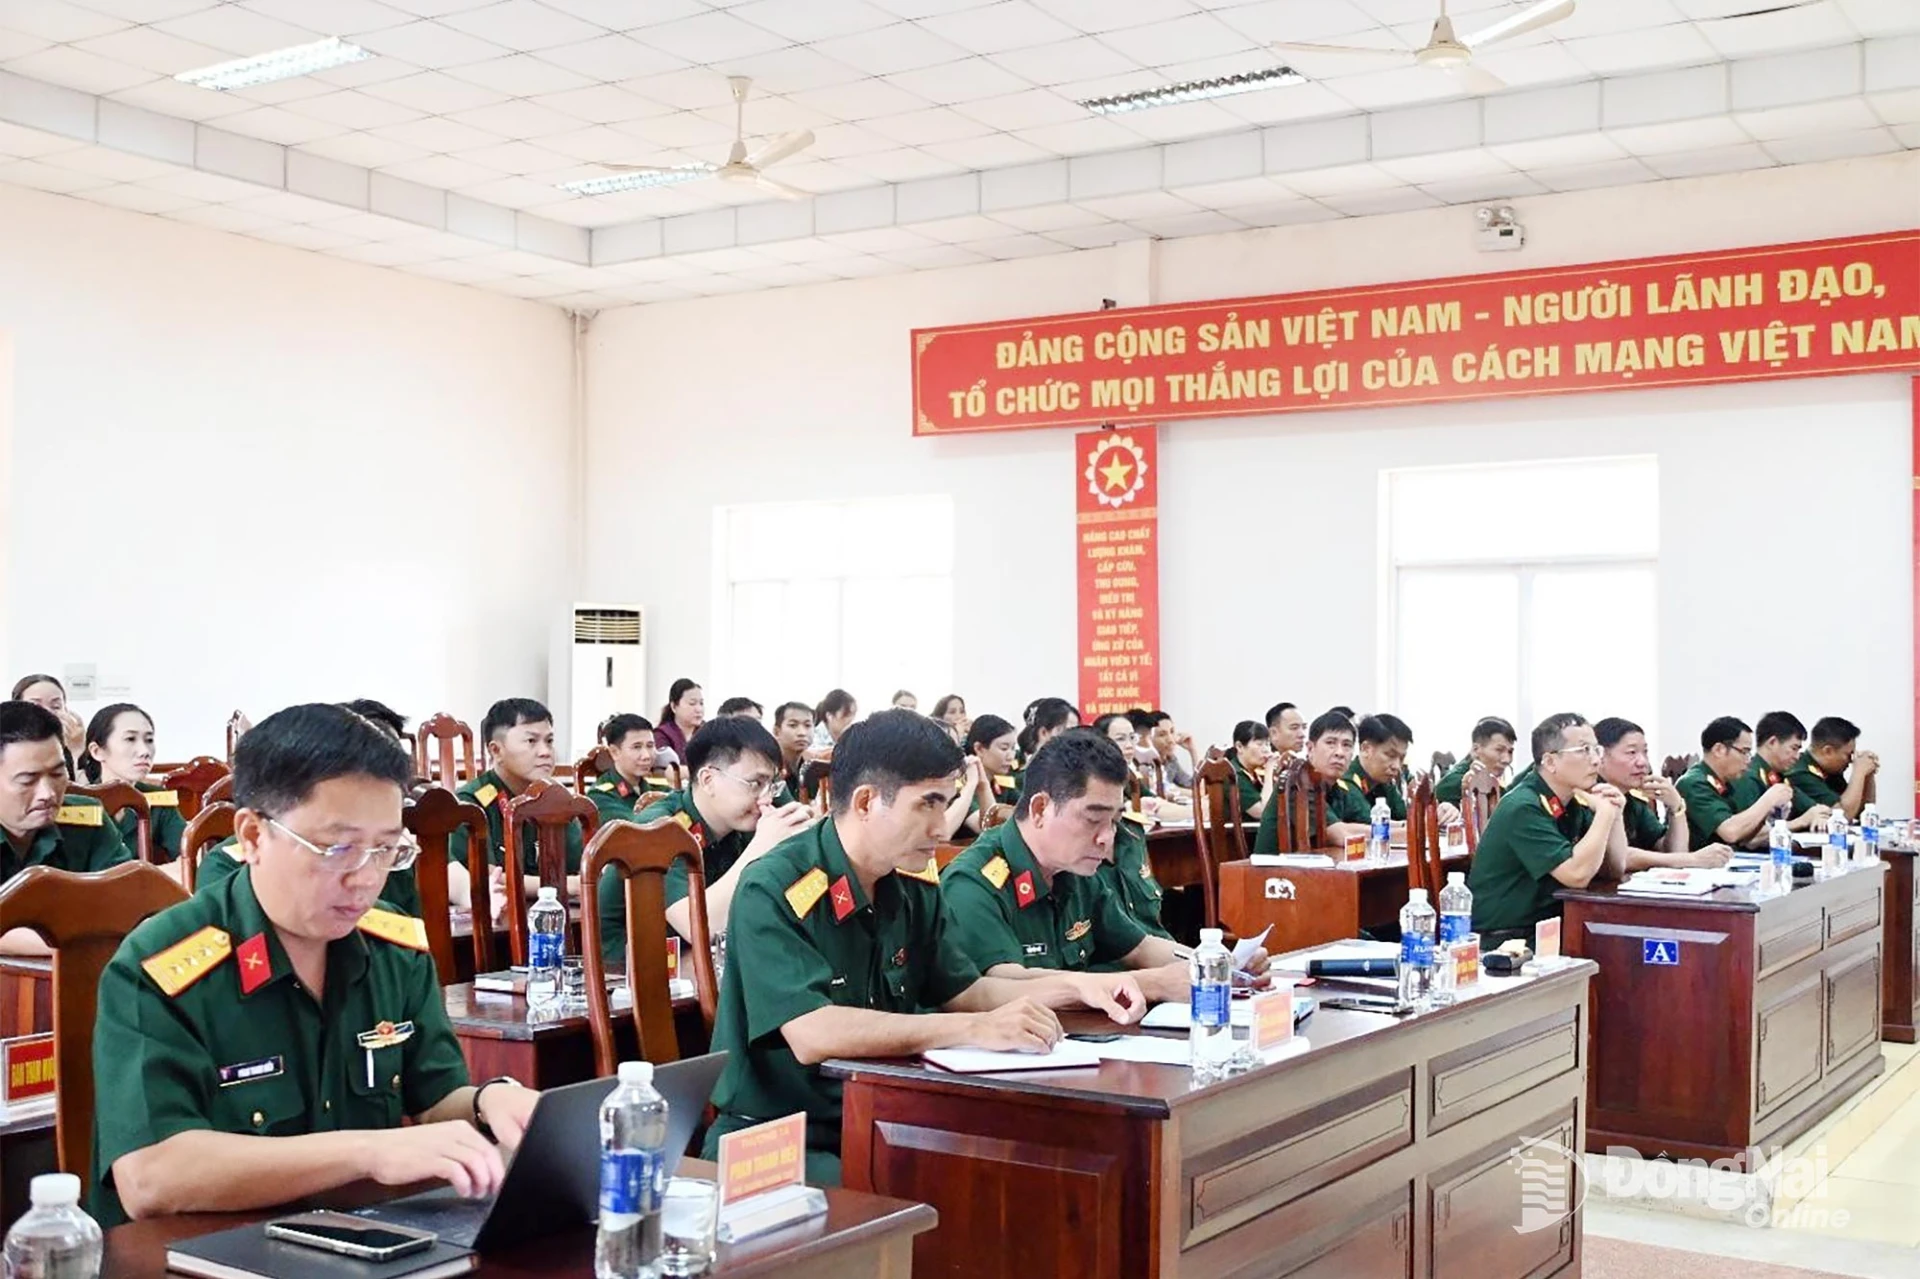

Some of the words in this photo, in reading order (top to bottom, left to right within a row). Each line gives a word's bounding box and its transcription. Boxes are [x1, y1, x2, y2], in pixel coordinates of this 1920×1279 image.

[996, 331, 1084, 368] ĐẢNG
[1094, 324, 1186, 365] CỘNG
[1198, 313, 1271, 353] SẢN
[1282, 307, 1359, 349] VIỆT
[1371, 301, 1462, 338] NAM
[1504, 280, 1632, 327] NGƯỜI
[1647, 273, 1763, 315] LÃNH
[1778, 262, 1886, 307] ĐẠO,
[949, 378, 987, 418] TỔ
[996, 378, 1081, 416] CHỨC
[1092, 377, 1155, 411] MỌI
[1166, 360, 1281, 403] THẮNG
[1294, 359, 1349, 399] LỢI
[1362, 348, 1440, 391] CỦA
[1452, 343, 1561, 385] CÁCH
[1575, 334, 1705, 378] MẠNG
[1720, 320, 1816, 368] VIỆT
[1651, 942, 1671, 962] A
